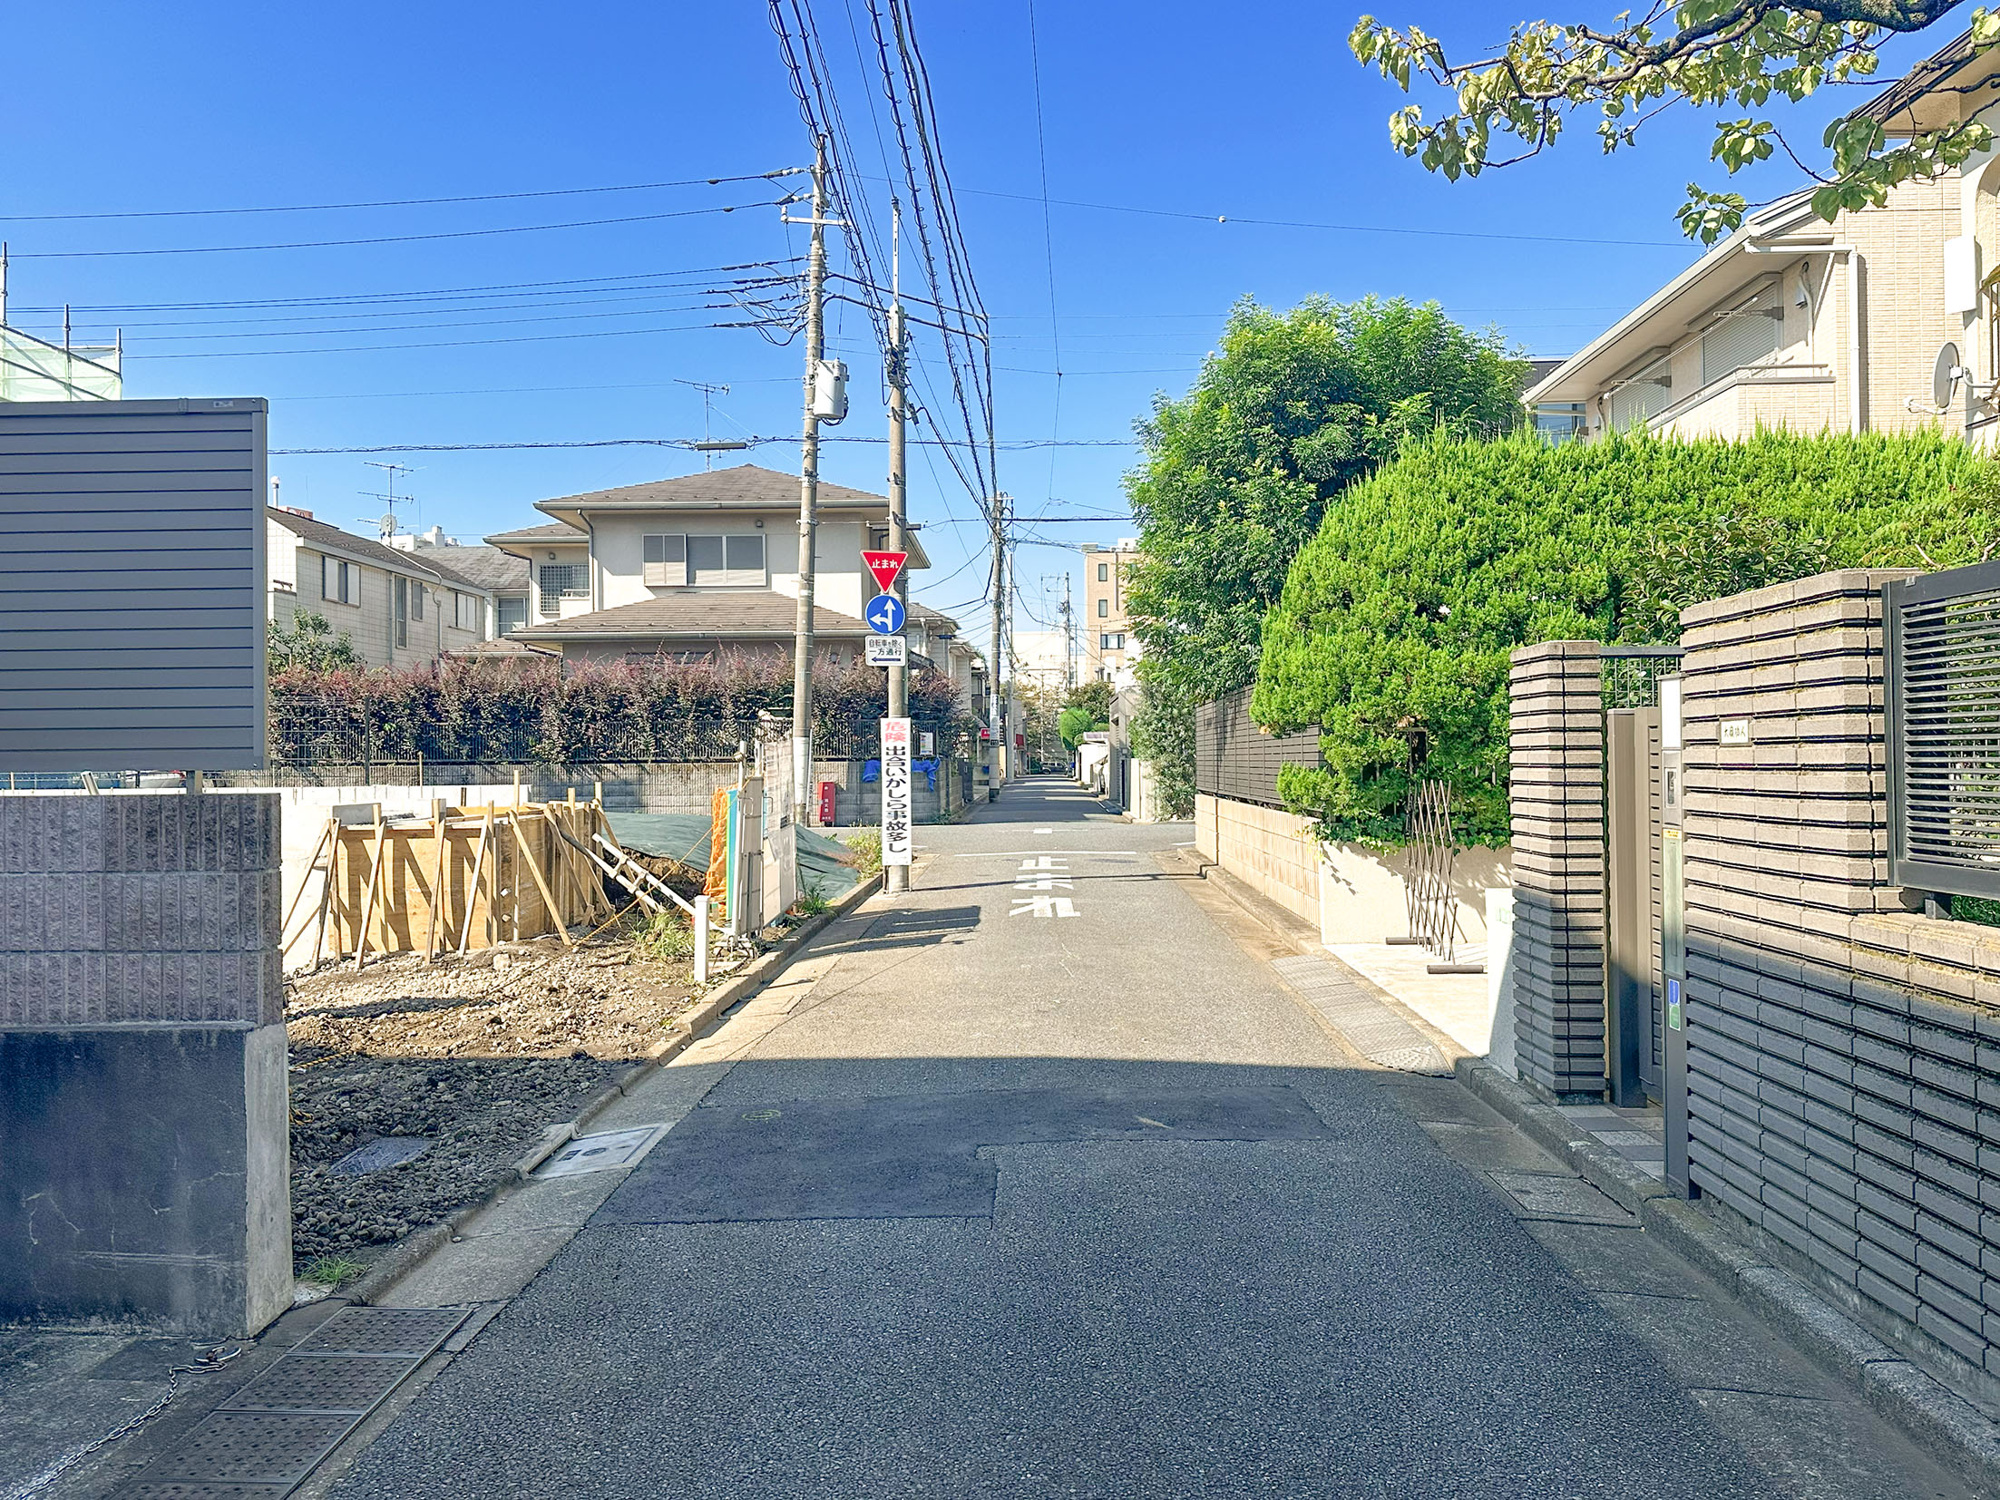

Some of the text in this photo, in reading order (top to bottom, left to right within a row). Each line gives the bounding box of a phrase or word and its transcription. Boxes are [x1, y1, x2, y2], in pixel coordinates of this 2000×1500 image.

[872, 559, 898, 568] 止まれ
[869, 639, 902, 648] 自転車を除く
[869, 648, 902, 656] 一方通行
[885, 722, 907, 743] 危険
[1009, 856, 1081, 918] 止まれ
